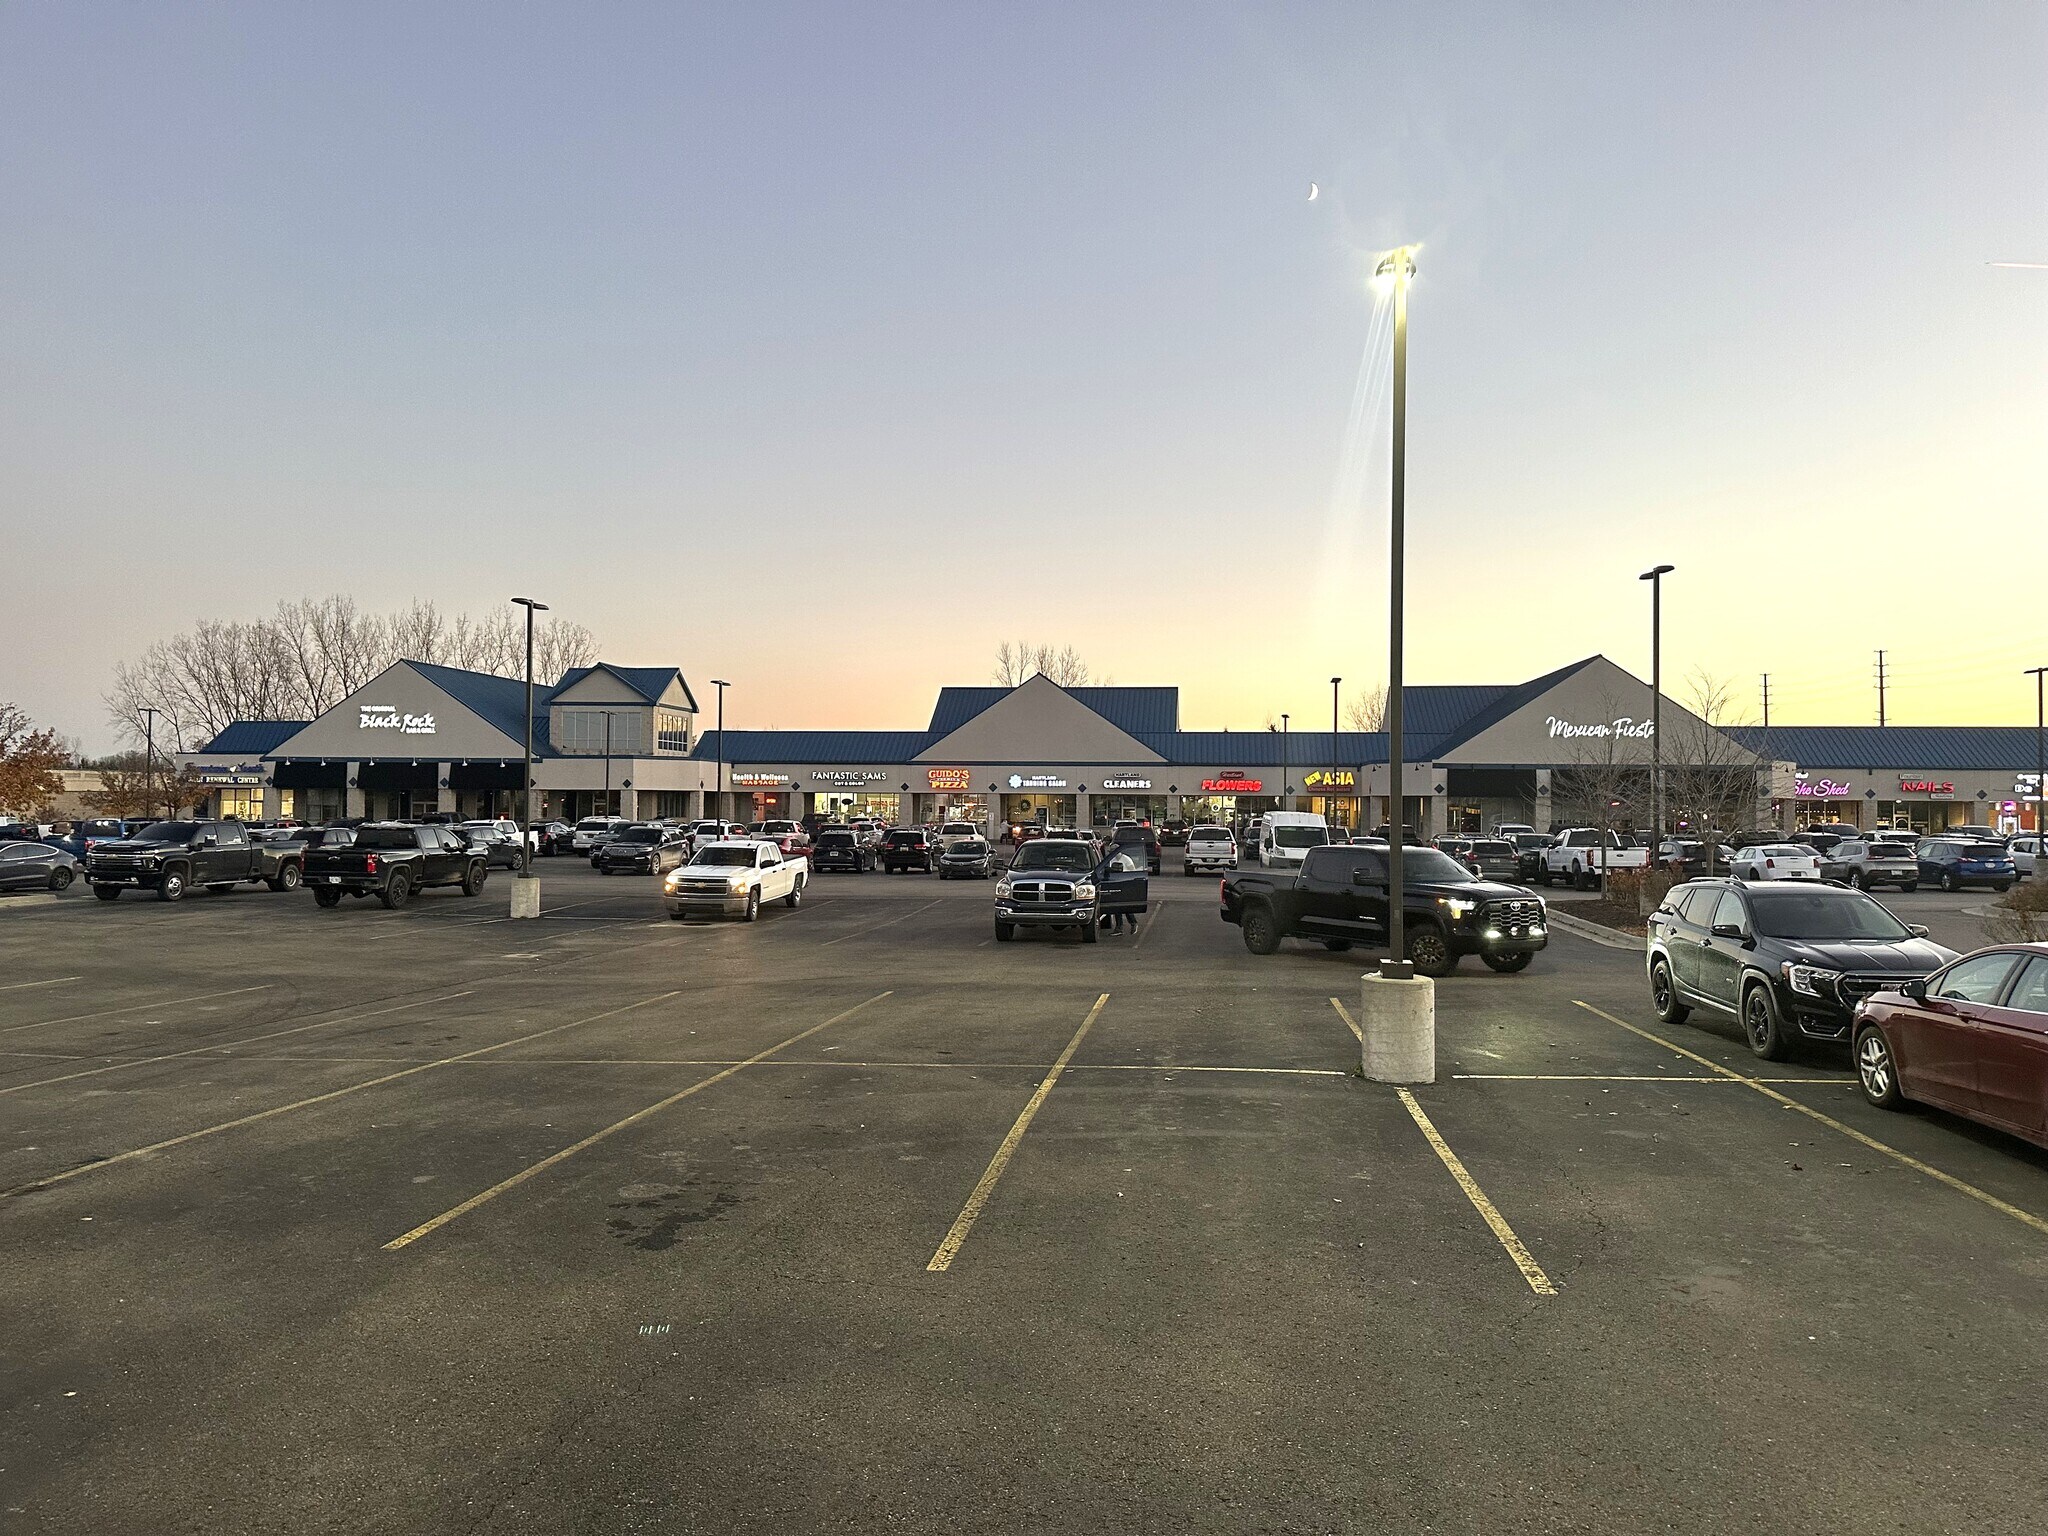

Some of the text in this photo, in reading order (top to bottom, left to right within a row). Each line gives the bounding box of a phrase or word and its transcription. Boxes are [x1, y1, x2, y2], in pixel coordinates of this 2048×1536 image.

[360, 713, 435, 732] Black Rock
[1545, 716, 1611, 738] Mexican
[812, 771, 887, 780] FANTASTIC SAMS
[928, 769, 970, 779] GUIDO'S
[1304, 771, 1355, 786] NEW ASIA
[931, 780, 968, 788] PIZZA
[1103, 780, 1151, 789] CLEANERS
[1201, 779, 1262, 791] FLOWERS
[1813, 779, 1851, 797] Shed
[1901, 781, 1954, 793] NAILS
